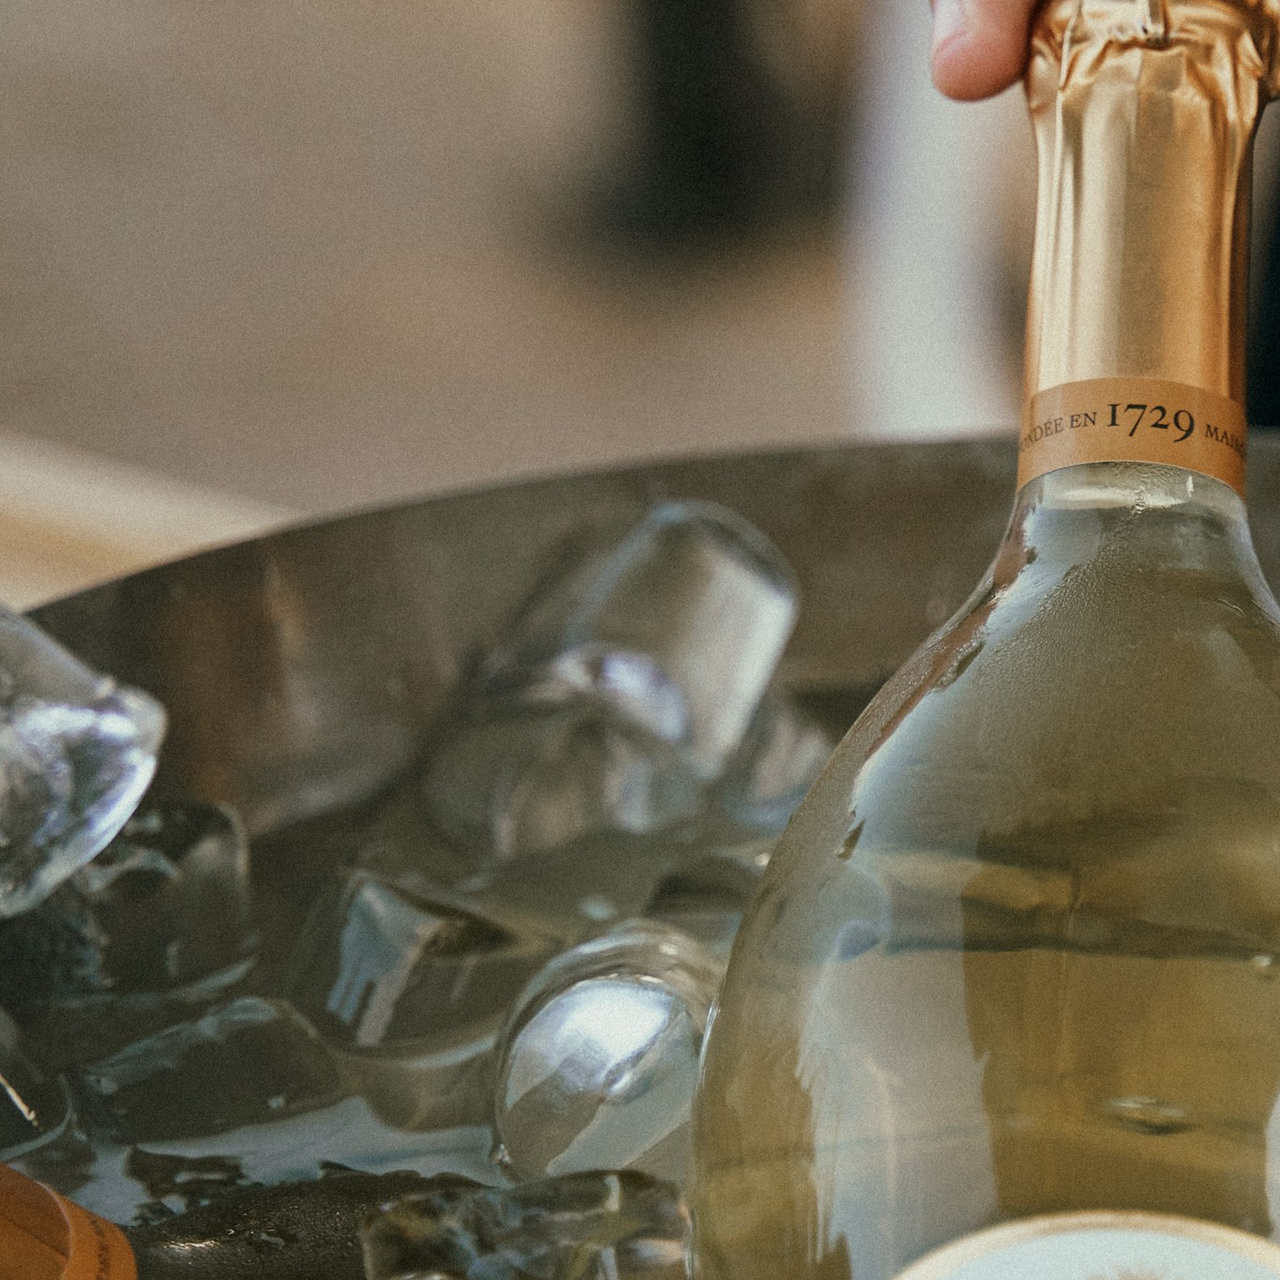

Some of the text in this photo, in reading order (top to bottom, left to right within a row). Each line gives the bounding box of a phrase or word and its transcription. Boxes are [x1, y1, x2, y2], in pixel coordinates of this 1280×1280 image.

[1021, 415, 1064, 451] NDÉE
[1069, 411, 1098, 429] EN
[1107, 403, 1195, 443] 1729
